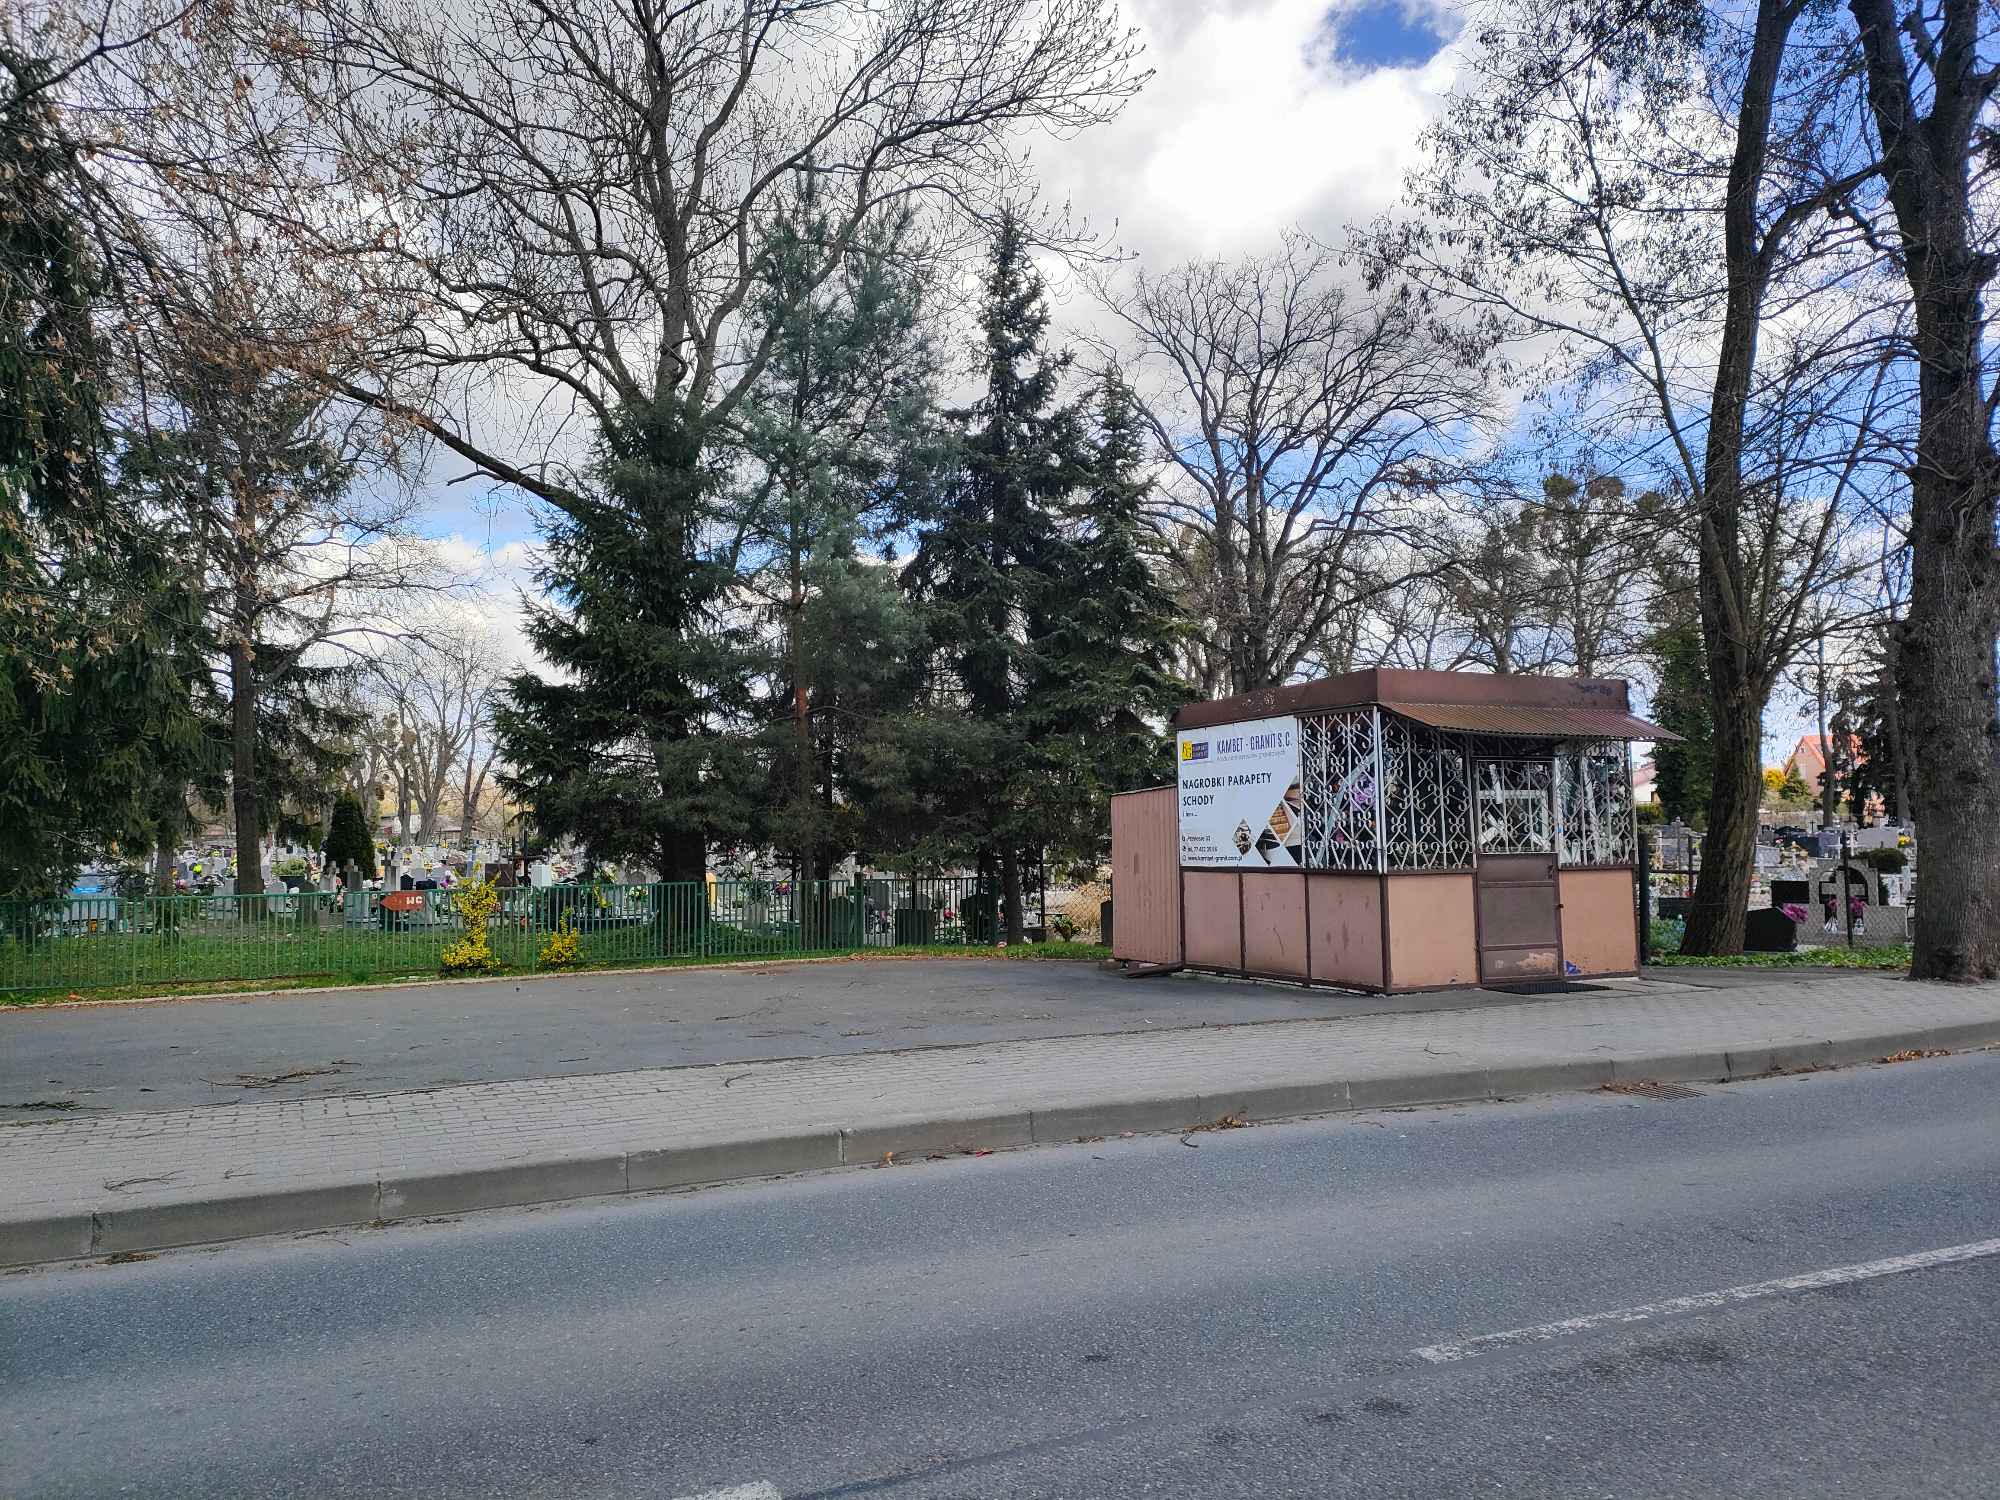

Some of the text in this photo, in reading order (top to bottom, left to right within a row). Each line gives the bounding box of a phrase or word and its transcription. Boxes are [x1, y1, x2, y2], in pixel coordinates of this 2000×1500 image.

[1217, 737, 1244, 754] KAMBET
[1250, 733, 1276, 750] GRANIT
[1182, 772, 1272, 790] NAGROBKI PARAPETY
[1183, 794, 1215, 807] SCHODY
[406, 895, 423, 905] WC
